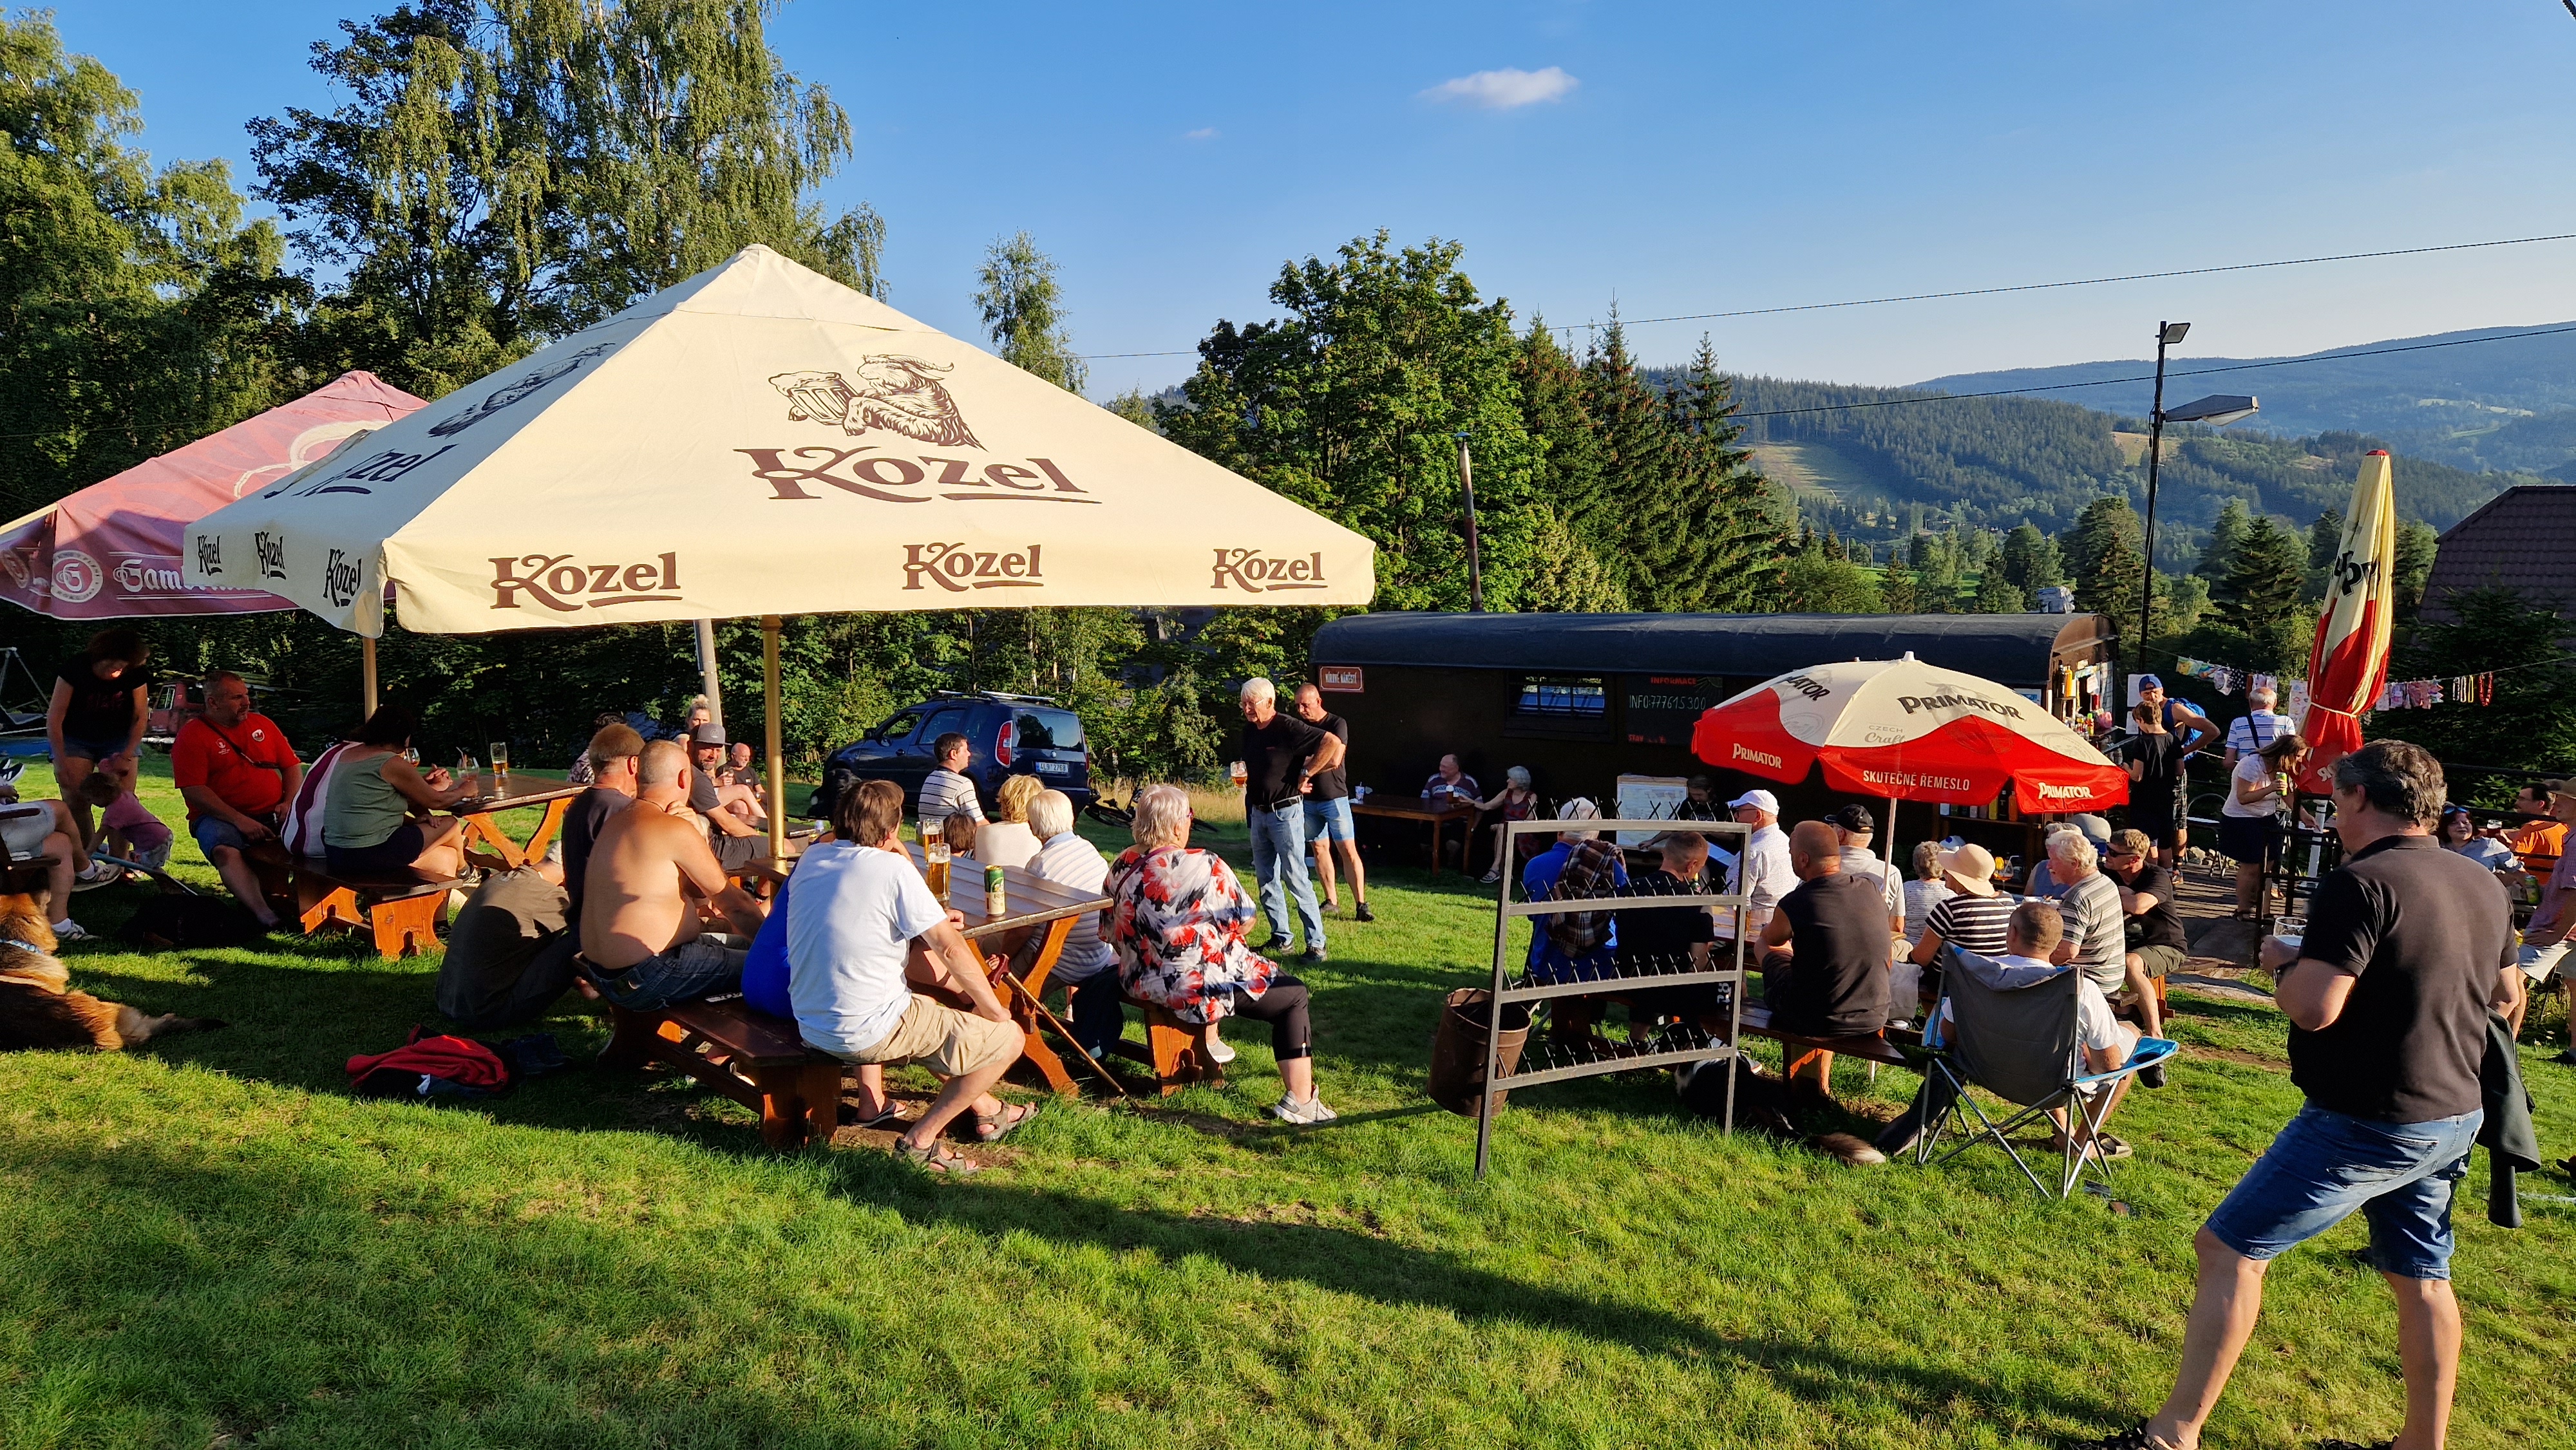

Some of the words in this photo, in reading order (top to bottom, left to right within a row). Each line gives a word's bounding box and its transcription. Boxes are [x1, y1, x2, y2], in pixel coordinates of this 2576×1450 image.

[733, 446, 1089, 504] Kozel
[197, 534, 221, 576] Kozel
[254, 531, 285, 579] Kozel
[902, 541, 1044, 592] Kozel
[1210, 547, 1325, 593] Kozel
[323, 548, 362, 607] Kozel
[488, 551, 683, 612] Kozel
[1897, 695, 2025, 720] PRIMATOR
[1864, 732, 1906, 744] Craft
[1868, 725, 1903, 733] CZECH
[1732, 743, 1782, 769] PRIMATOR
[1863, 769, 1917, 787] SKUTEČNÉ
[1920, 771, 1970, 791] ŘEMESLO
[2038, 782, 2093, 800] PRIMATOR
